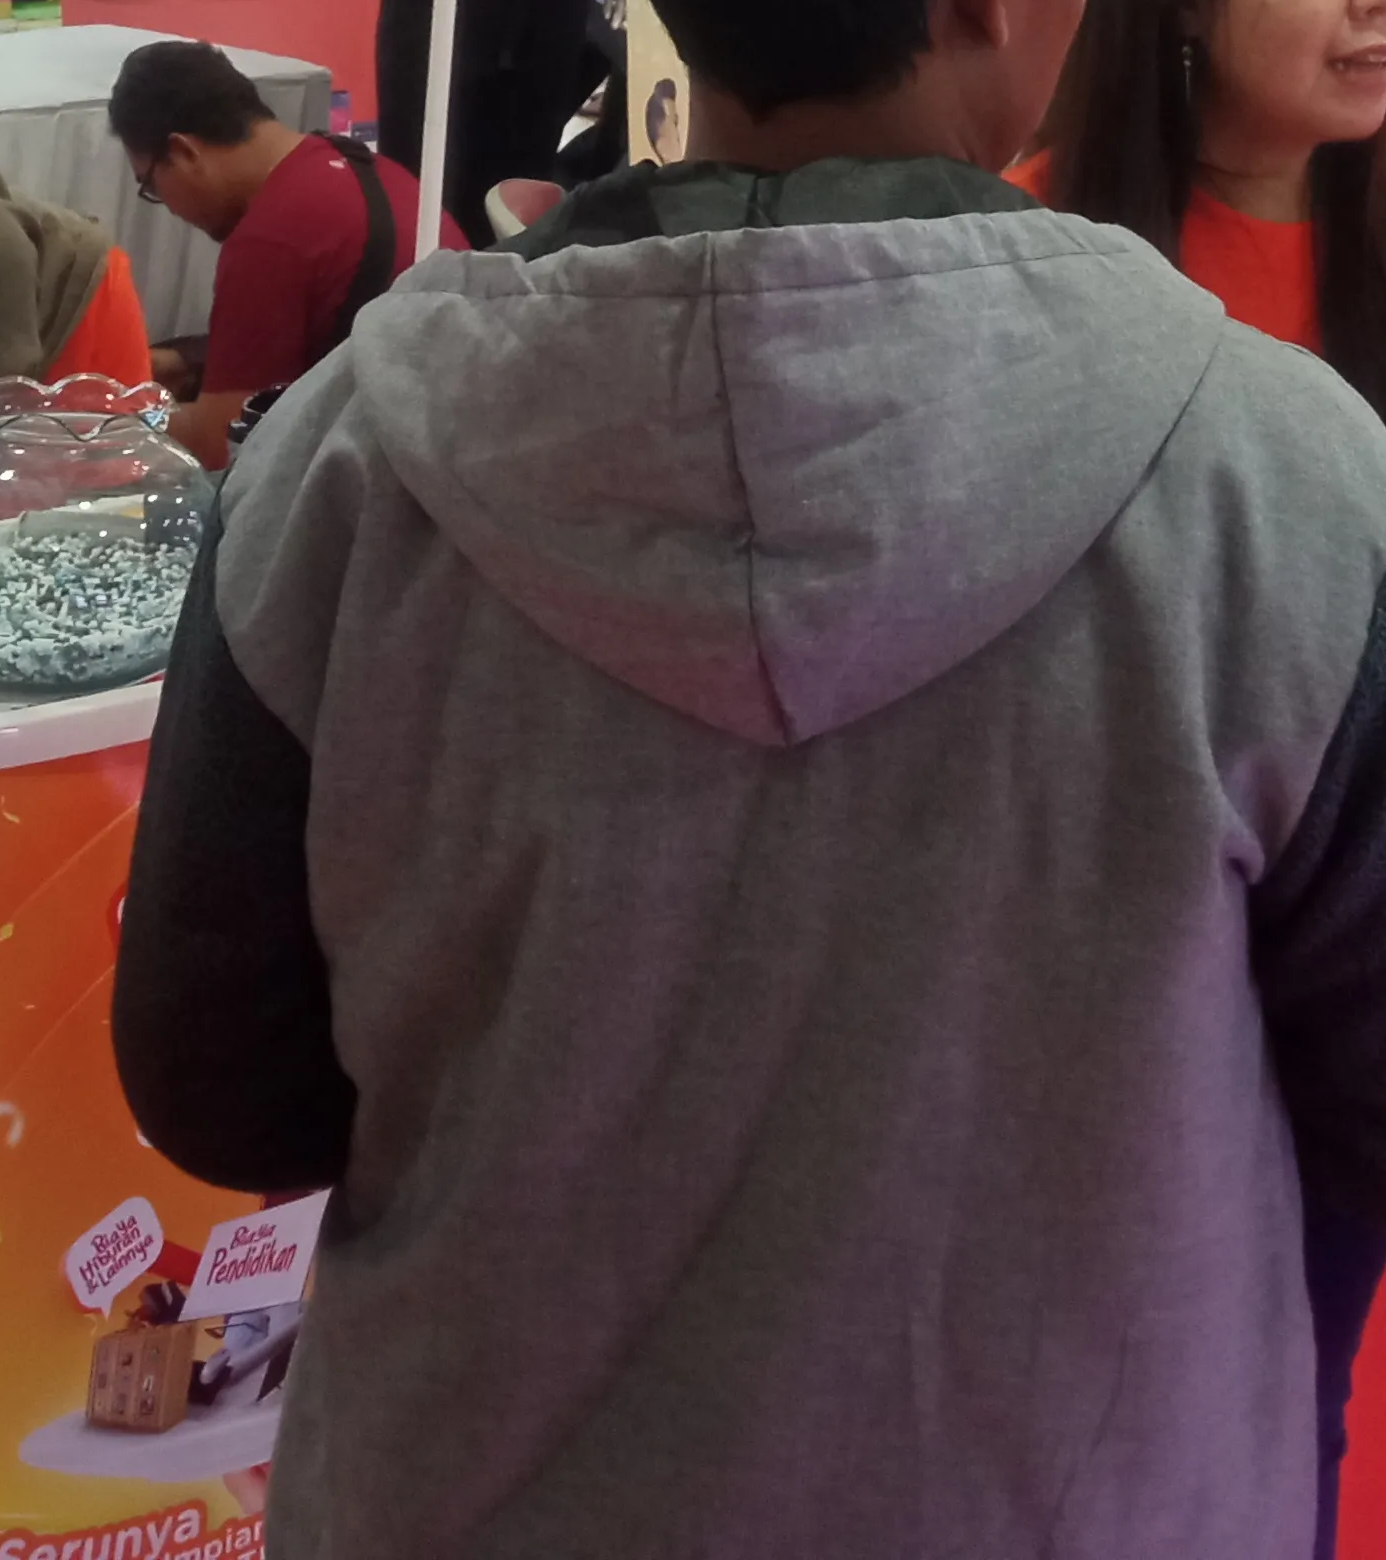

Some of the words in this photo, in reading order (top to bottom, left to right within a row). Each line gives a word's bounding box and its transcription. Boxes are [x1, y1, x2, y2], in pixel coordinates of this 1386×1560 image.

[79, 1227, 141, 1281] Hiburan
[91, 1215, 138, 1254] Biaya
[230, 1222, 277, 1250] Biaya
[206, 1241, 298, 1286] Pendidikan
